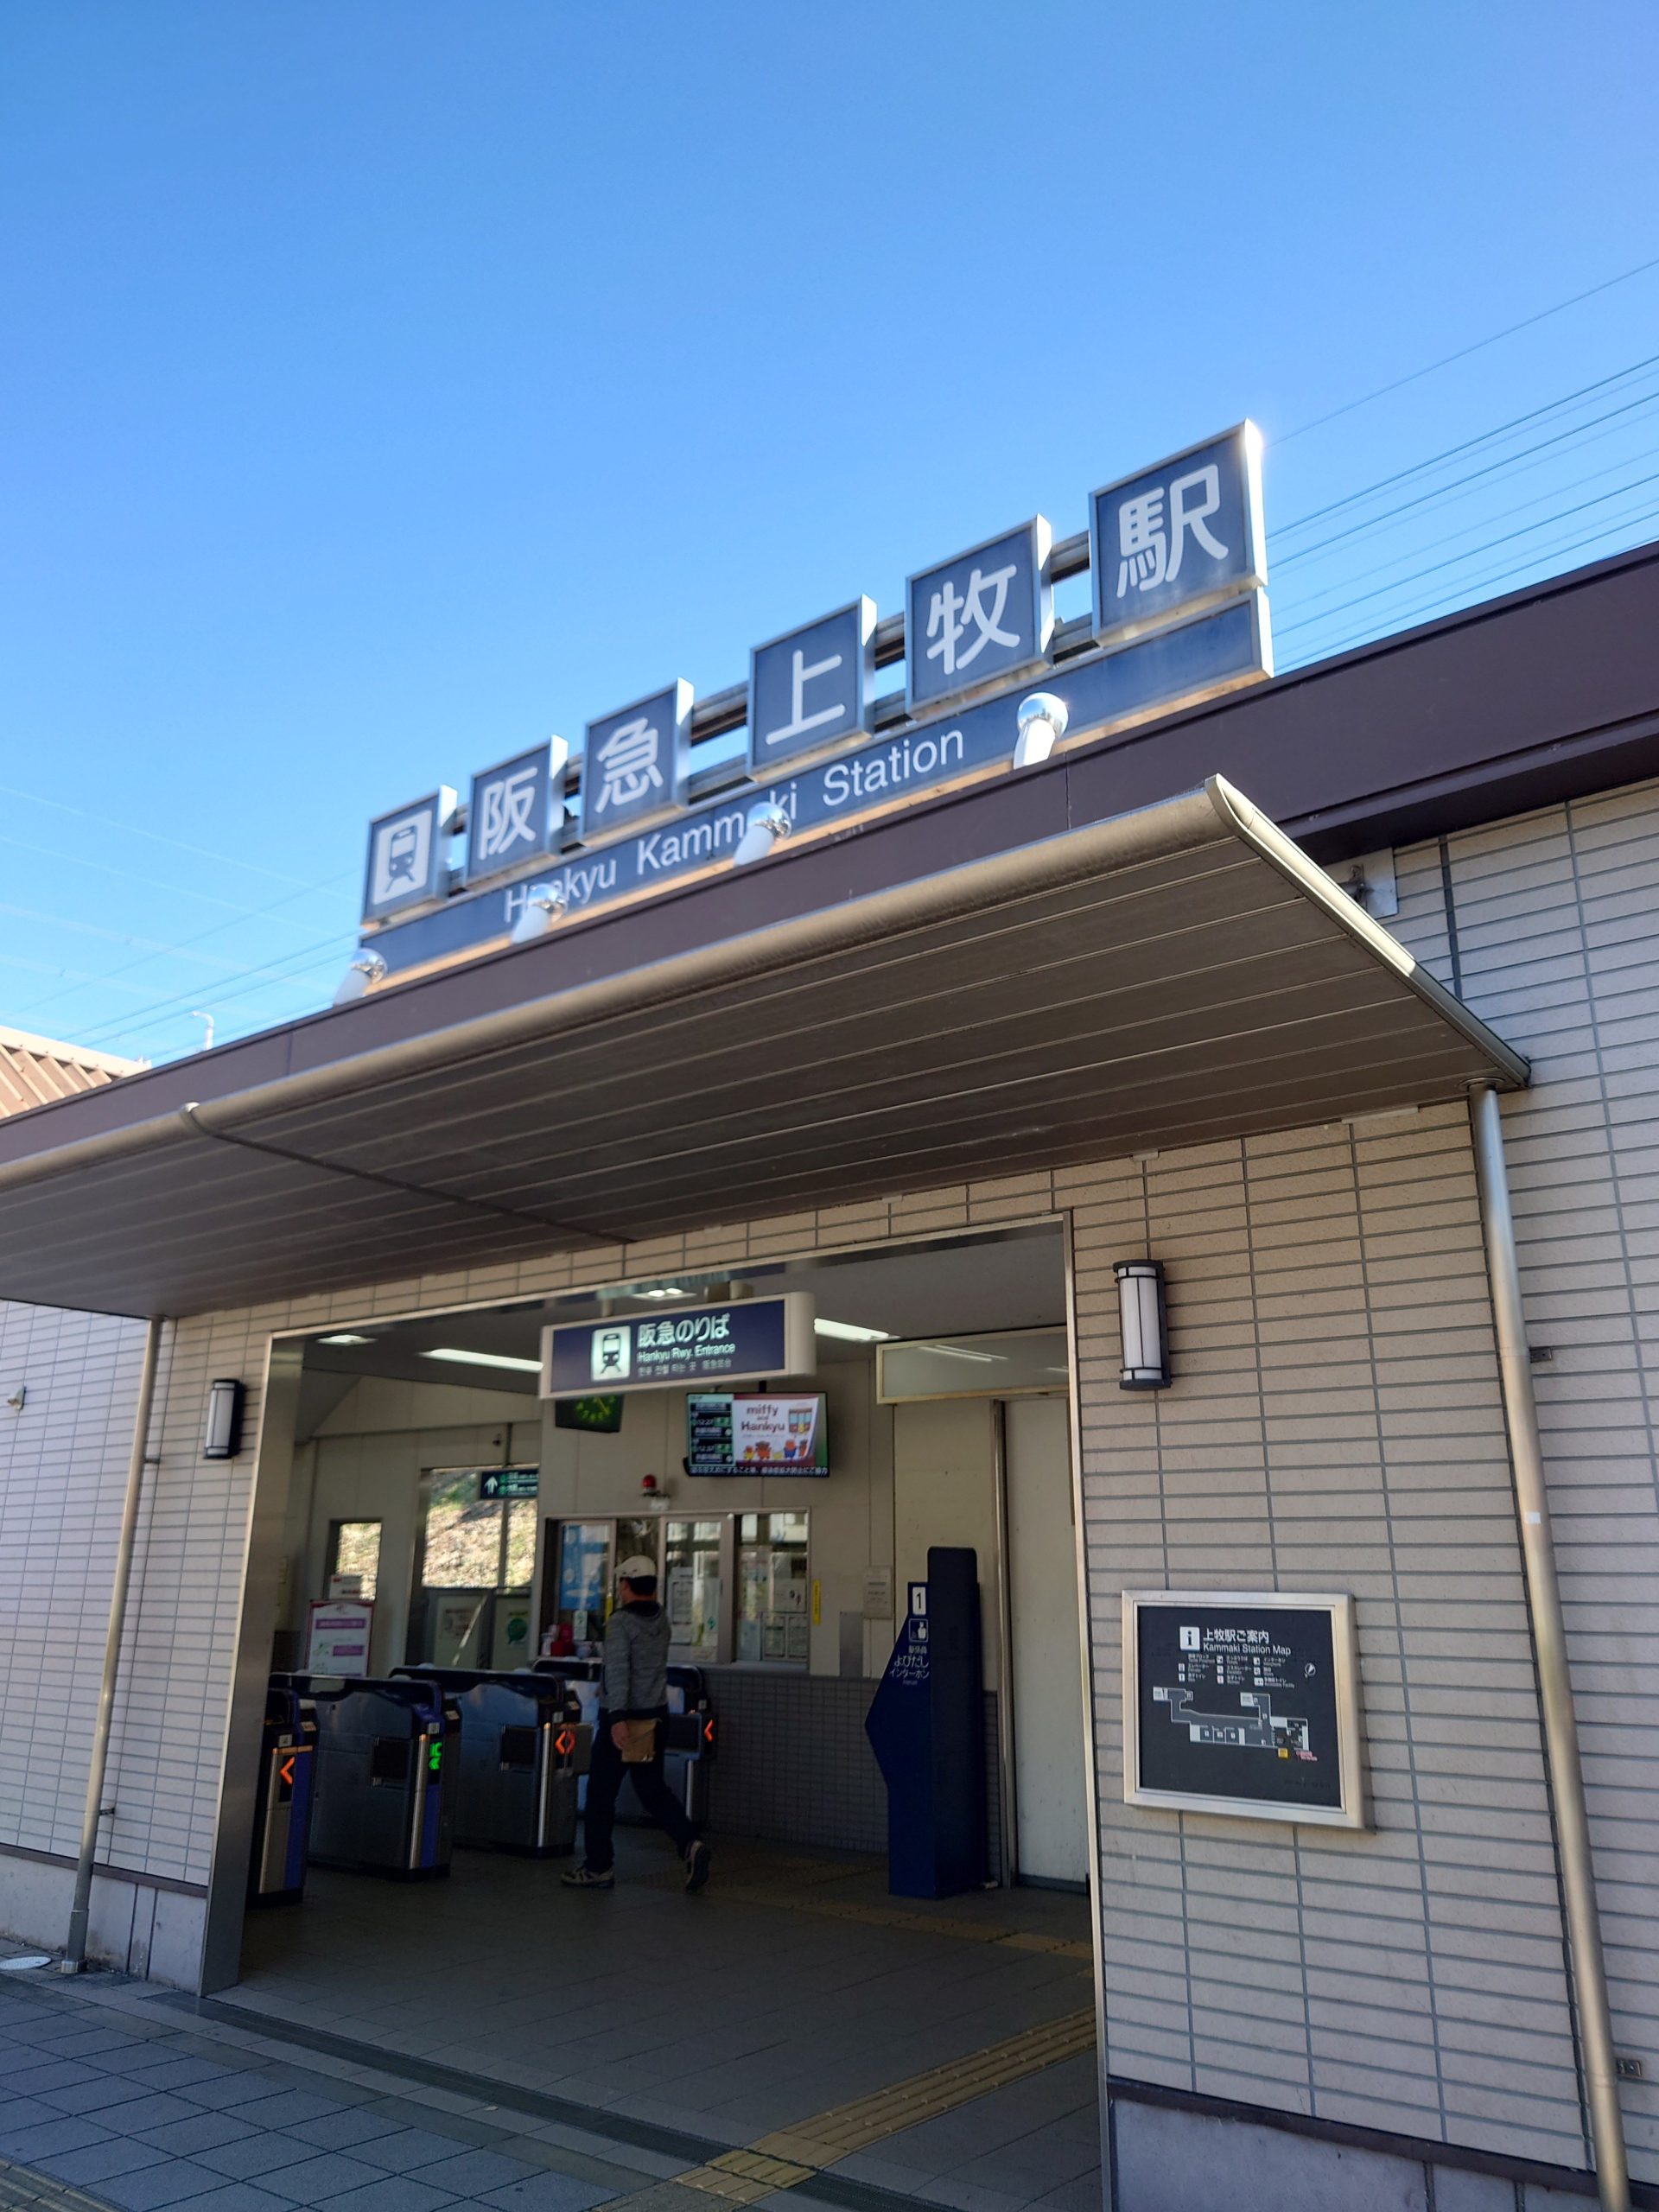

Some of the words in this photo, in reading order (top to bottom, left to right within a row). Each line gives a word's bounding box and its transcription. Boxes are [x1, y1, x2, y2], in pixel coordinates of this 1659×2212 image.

[504, 861, 617, 923] Hkyu
[637, 782, 797, 875] Kammki
[823, 729, 964, 806] Station
[638, 1313, 730, 1347] 阪急のりば
[637, 1349, 671, 1363] Hankyu
[694, 1343, 736, 1357] Entrance
[747, 1404, 779, 1415] miffy
[741, 1421, 785, 1433] Hankyu
[1203, 1627, 1269, 1644] 上牧駅ご案内
[1203, 1643, 1241, 1653] Kammaki
[1242, 1643, 1271, 1656] Station
[1273, 1644, 1292, 1658] Map
[893, 1654, 930, 1668] よびだし
[889, 1667, 930, 1680] インターホン
